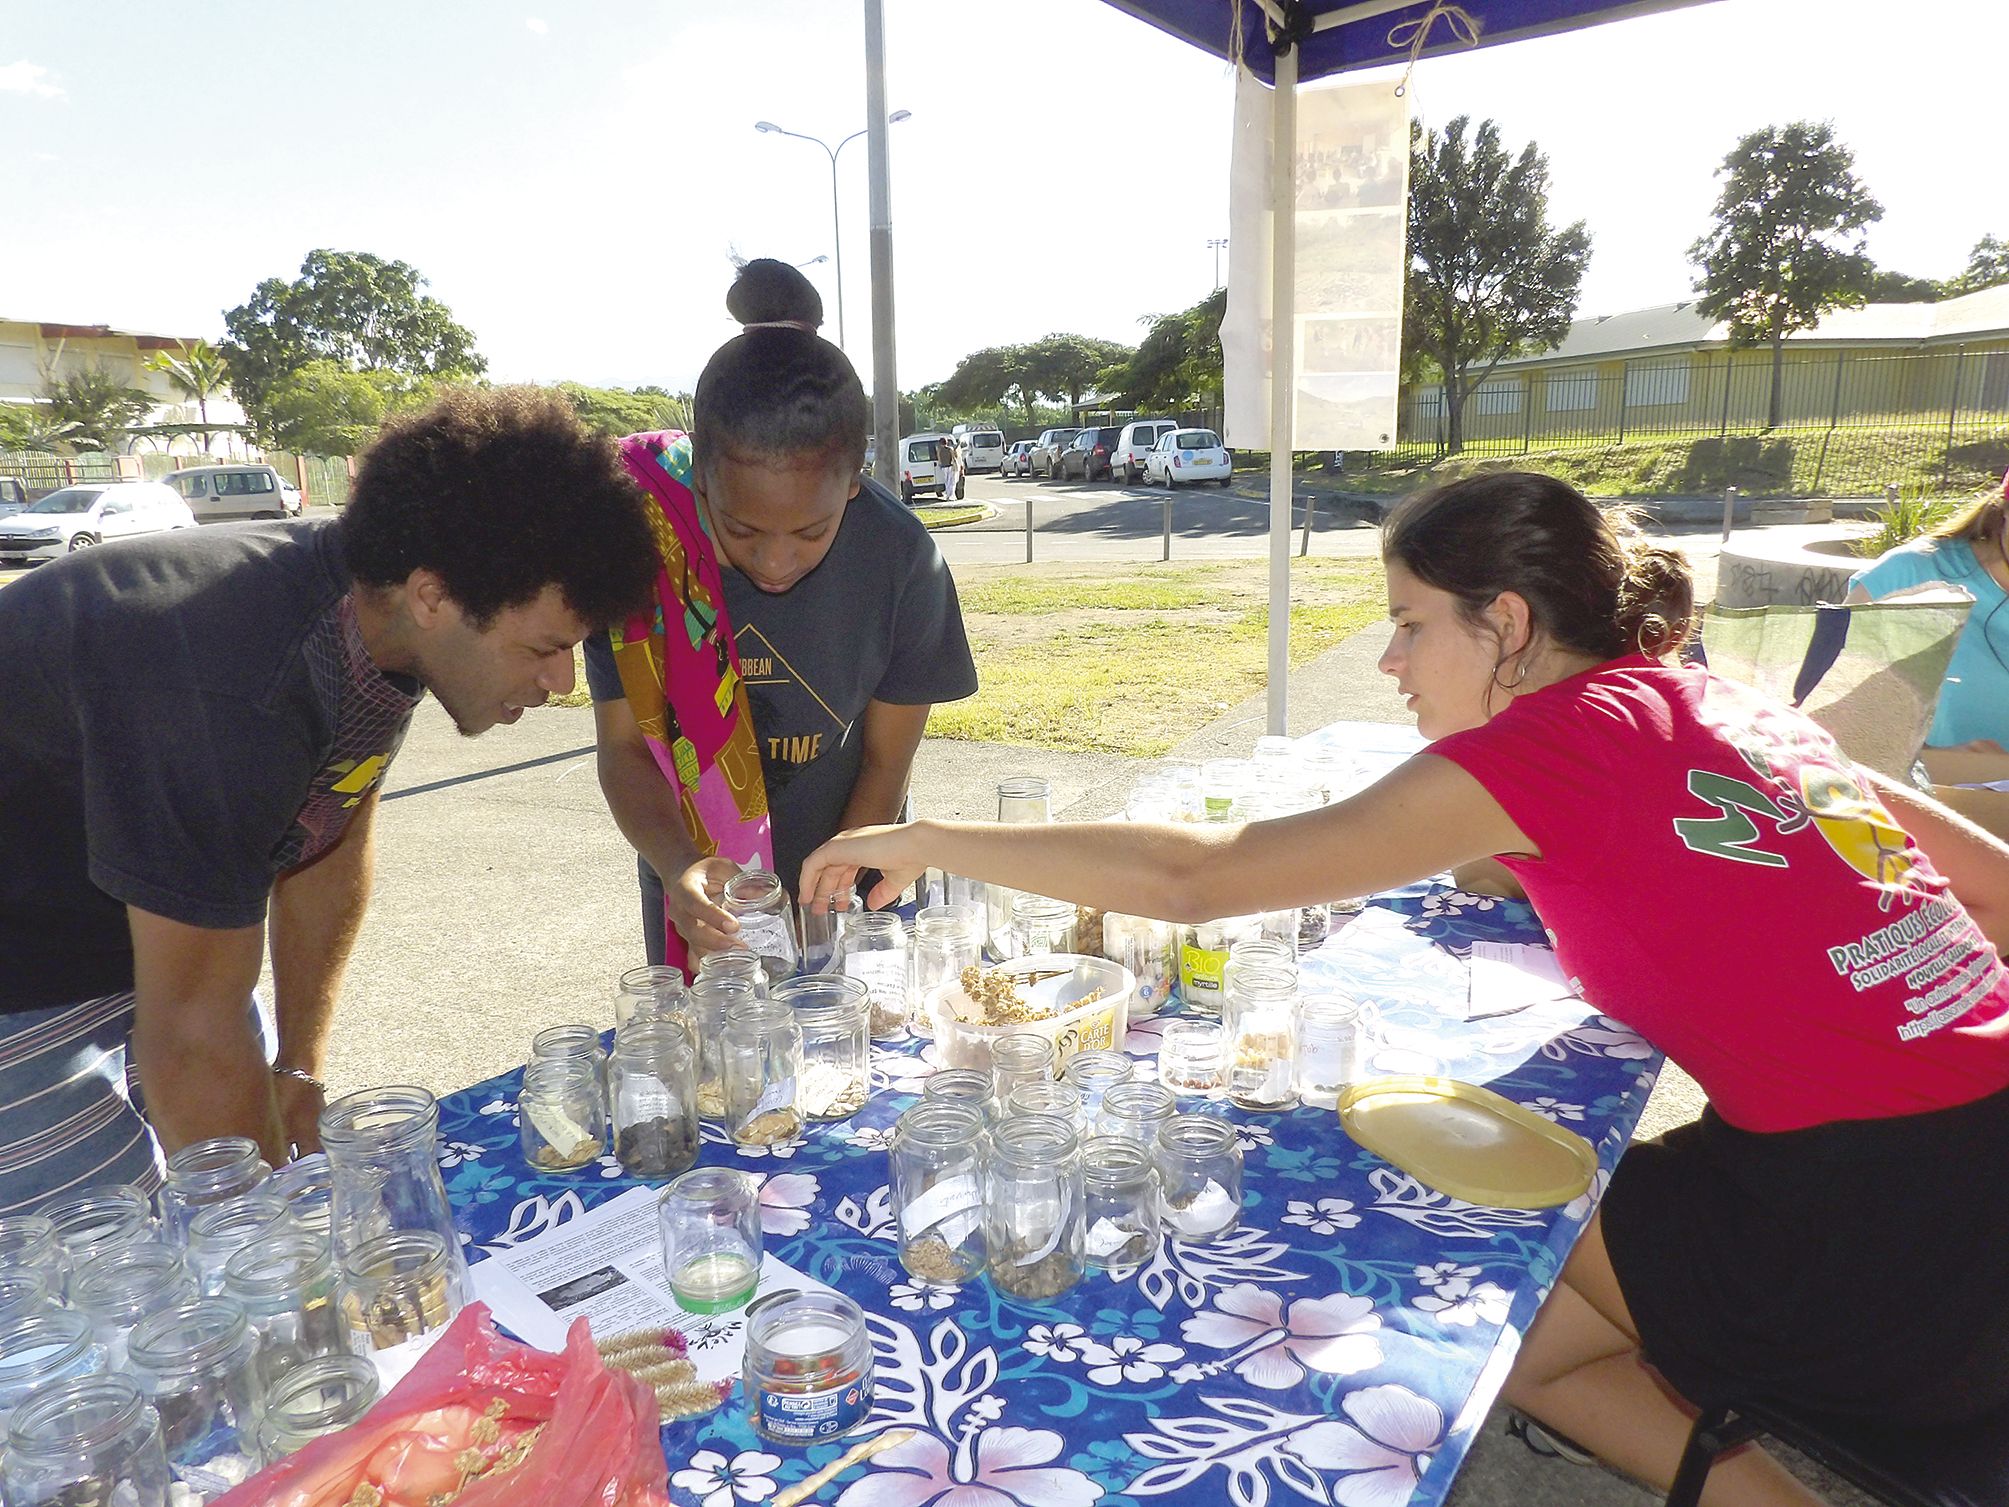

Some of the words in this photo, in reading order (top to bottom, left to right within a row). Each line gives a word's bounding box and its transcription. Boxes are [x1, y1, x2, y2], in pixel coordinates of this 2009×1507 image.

[768, 733, 822, 763] TIME
[1828, 911, 1926, 975] PRATIQUES
[1186, 950, 1220, 975] BIO
[1080, 1023, 1110, 1044] CARTE
